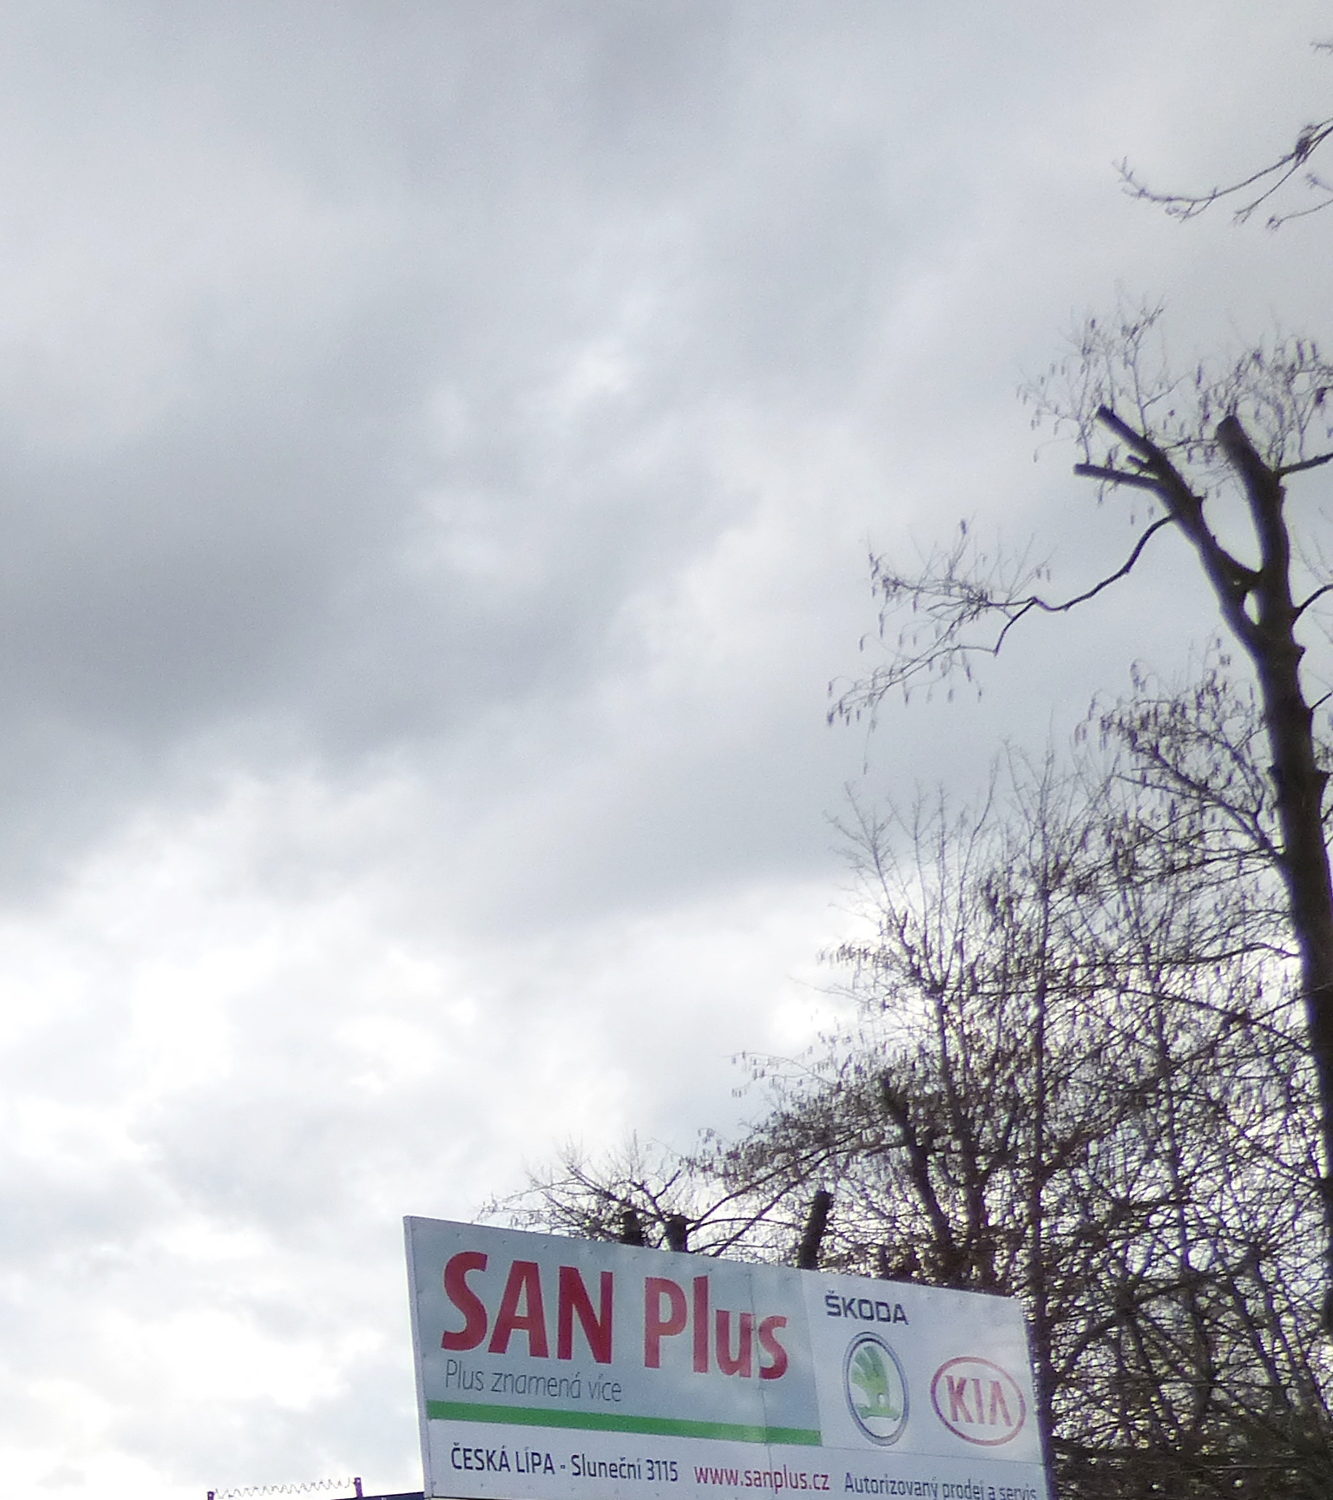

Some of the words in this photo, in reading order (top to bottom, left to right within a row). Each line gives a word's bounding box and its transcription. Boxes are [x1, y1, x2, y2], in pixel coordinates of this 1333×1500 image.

[440, 1250, 613, 1364] SAN
[644, 1274, 789, 1380] Plus
[824, 1290, 910, 1326] ŠKODA
[444, 1358, 485, 1391] Plus
[491, 1370, 582, 1399] znamená
[588, 1374, 623, 1402] více
[945, 1374, 1013, 1428] KIA
[450, 1441, 511, 1473] ČESKÁ
[515, 1446, 556, 1475] LÍPA
[571, 1453, 642, 1480] Sluneční
[646, 1459, 679, 1482] 3115
[693, 1464, 831, 1494] www.sanplus.cz
[988, 1484, 996, 1500] a
